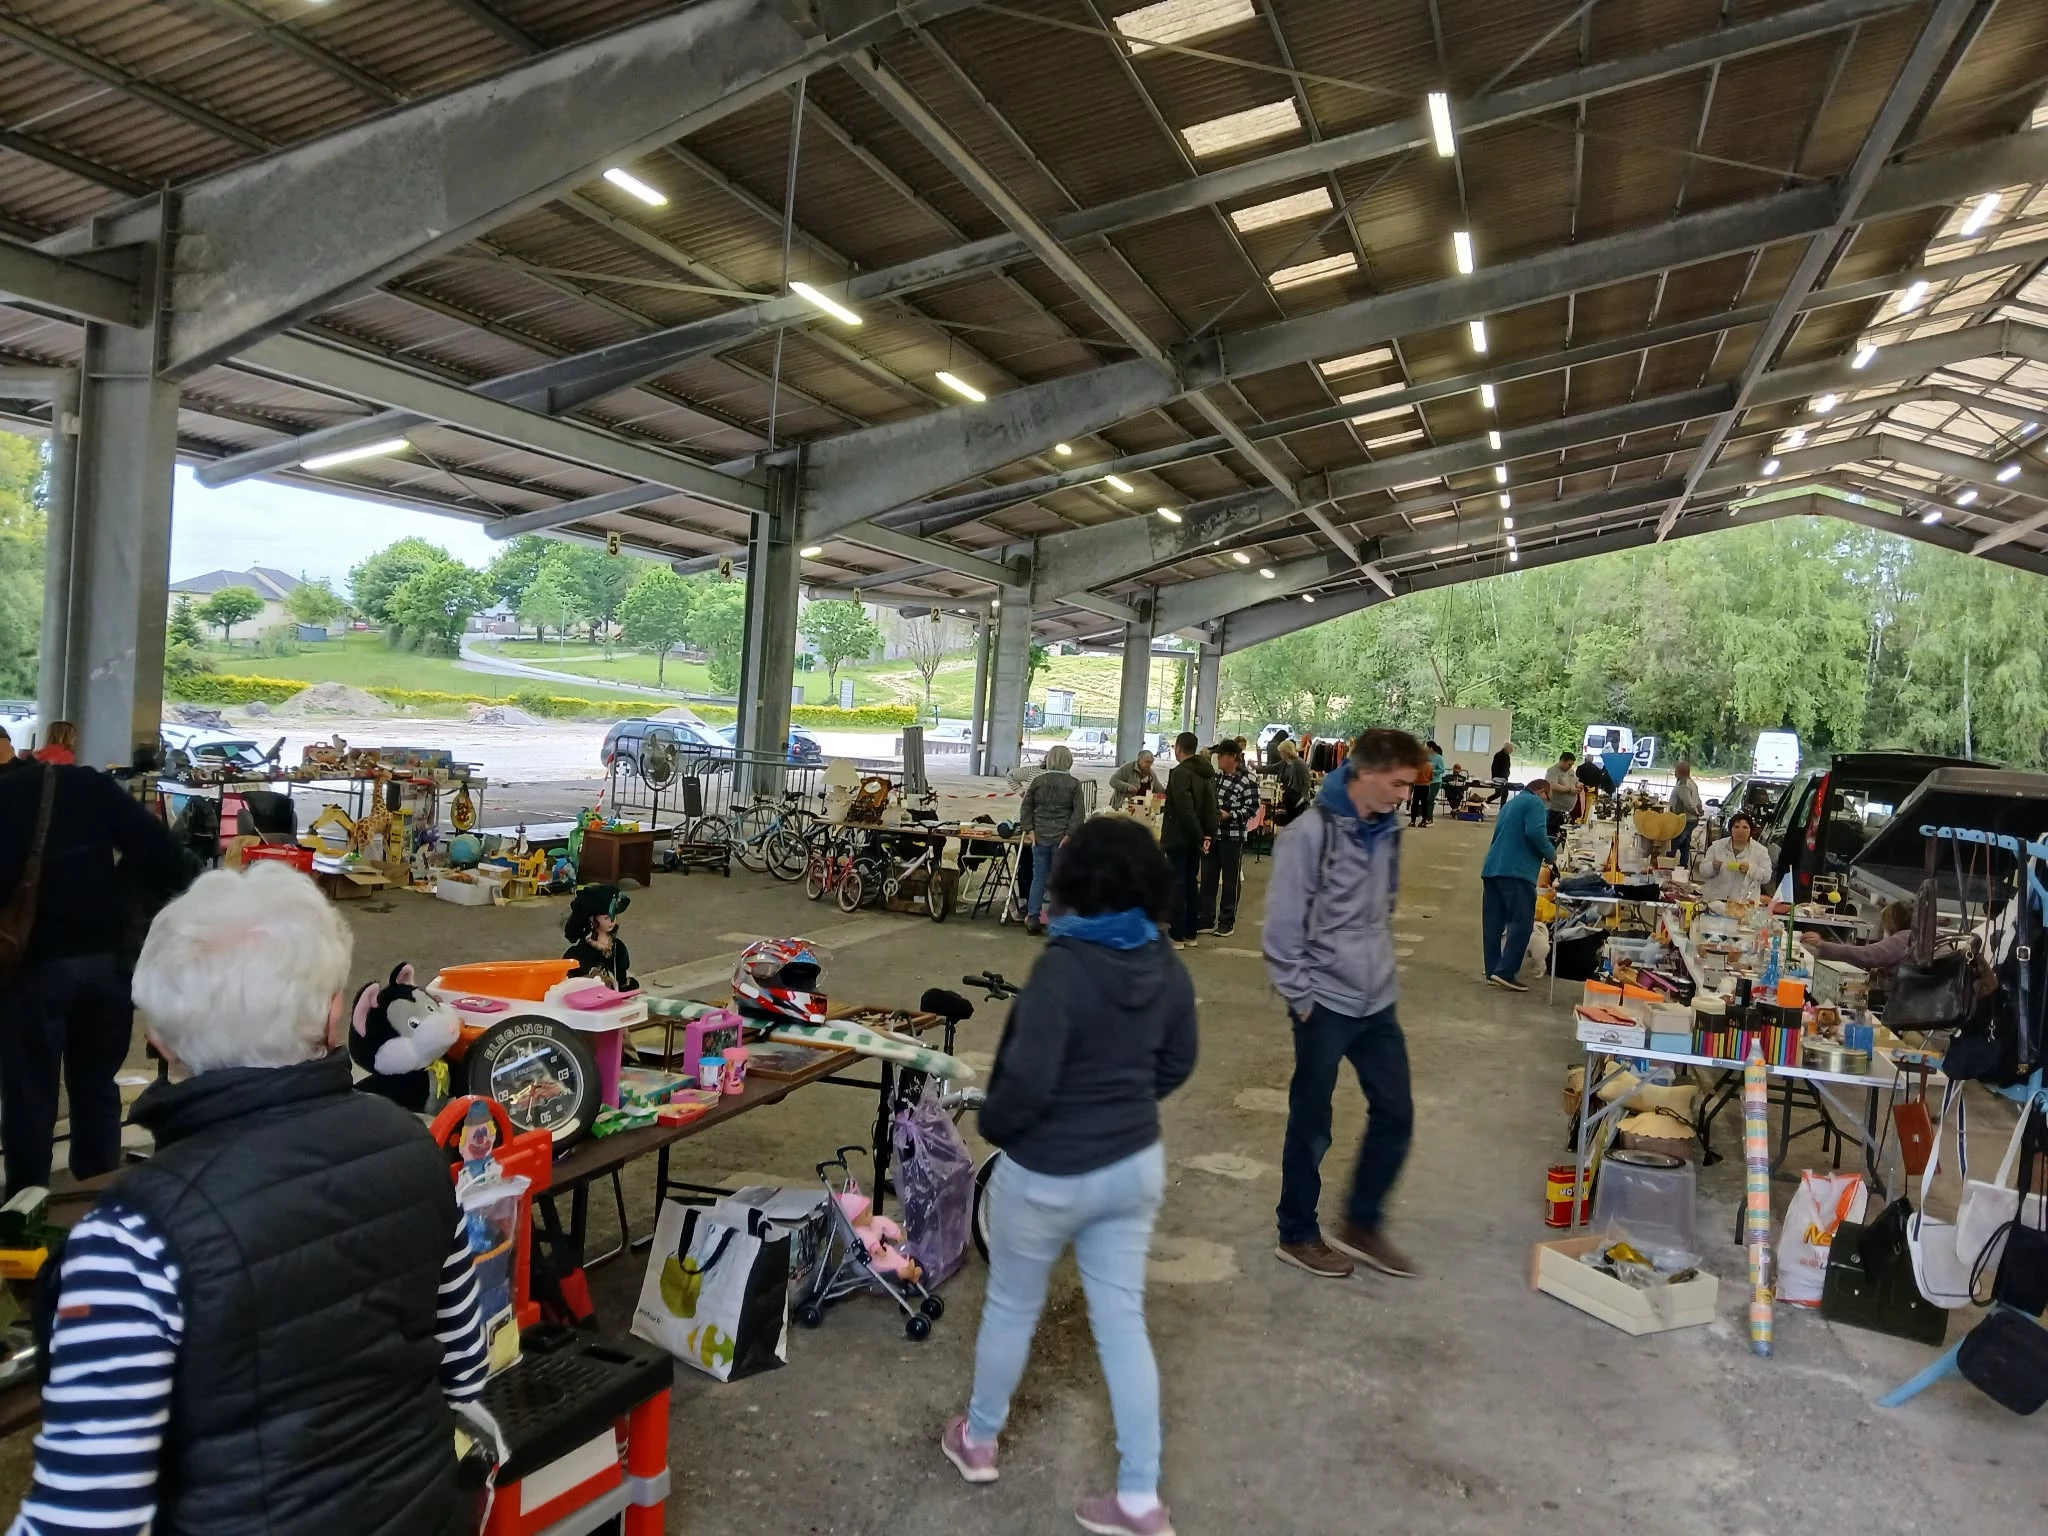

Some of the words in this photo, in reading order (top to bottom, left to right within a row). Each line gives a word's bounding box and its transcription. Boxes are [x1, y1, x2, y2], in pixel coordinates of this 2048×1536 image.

[609, 536, 618, 555] 5
[720, 561, 731, 579] 4
[854, 590, 860, 605] 3
[932, 608, 940, 621] 2
[484, 1023, 553, 1061] ELEGANCE
[558, 1068, 569, 1081] 03
[498, 1089, 509, 1102] 09
[540, 1111, 552, 1123] 06
